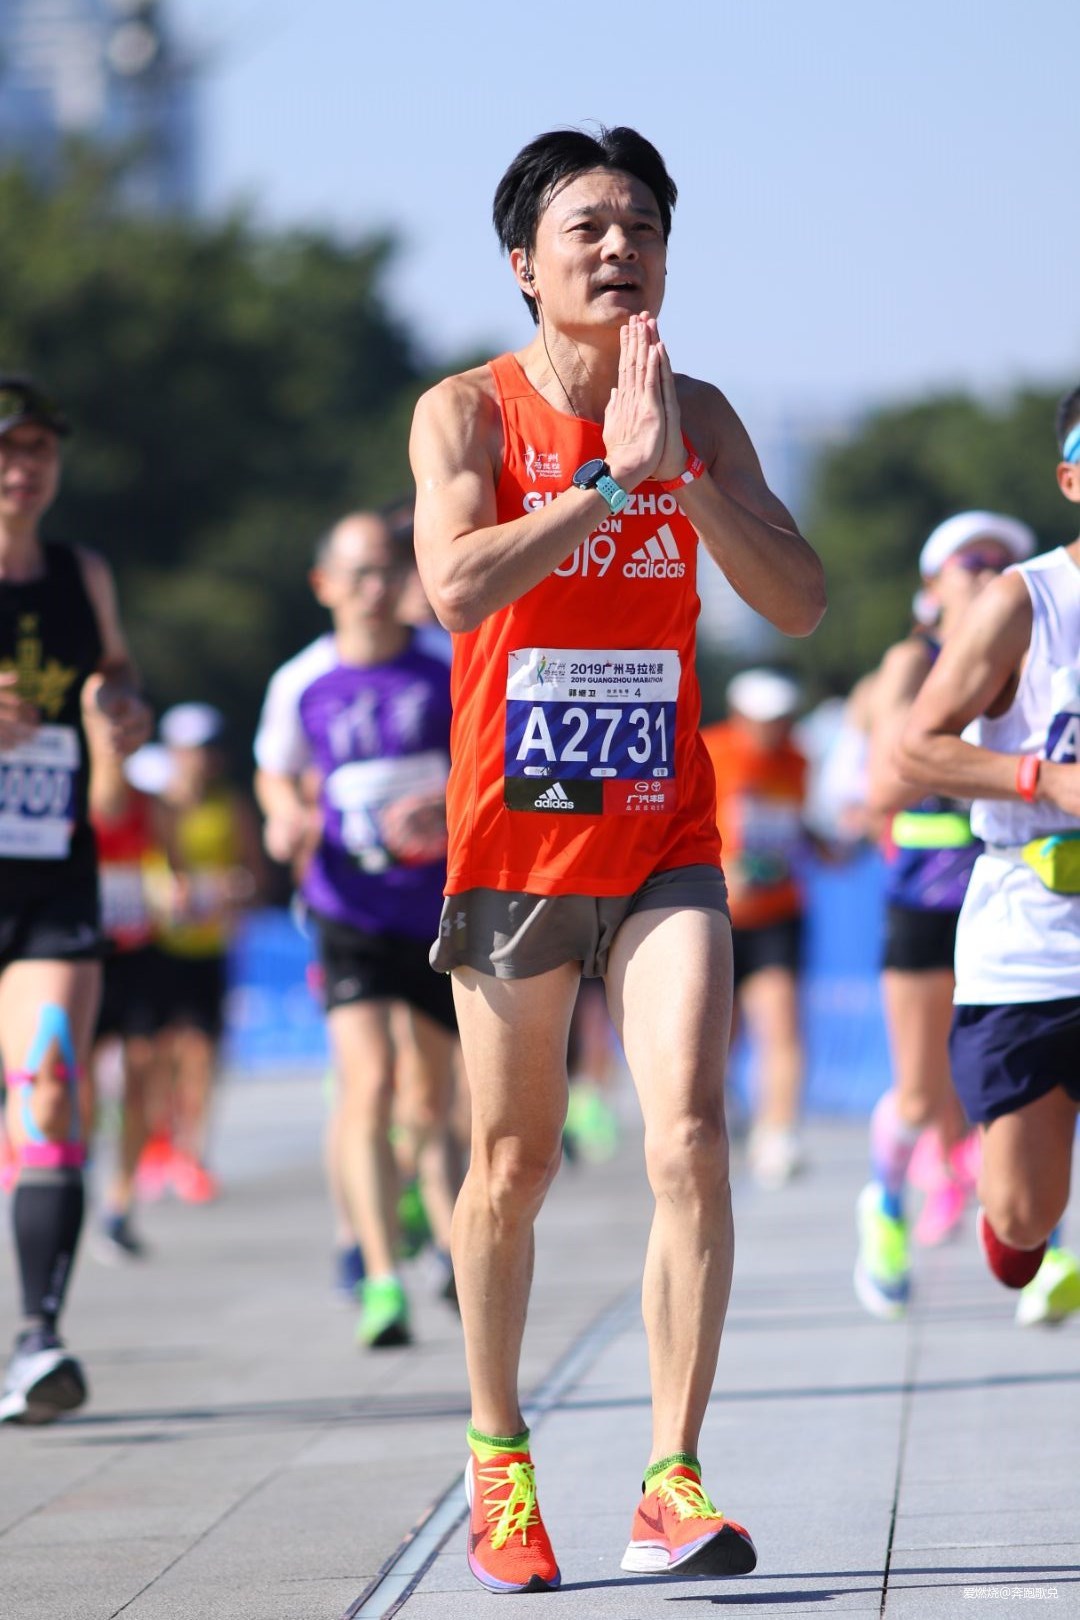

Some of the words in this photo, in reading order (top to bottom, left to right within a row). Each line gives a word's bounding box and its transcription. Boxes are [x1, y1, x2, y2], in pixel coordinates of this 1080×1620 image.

[622, 558, 685, 578] adidas
[570, 663, 664, 675] 2019广州马拉松赛
[634, 688, 641, 698] 4
[516, 706, 667, 763] A2731
[534, 798, 575, 810] adidas
